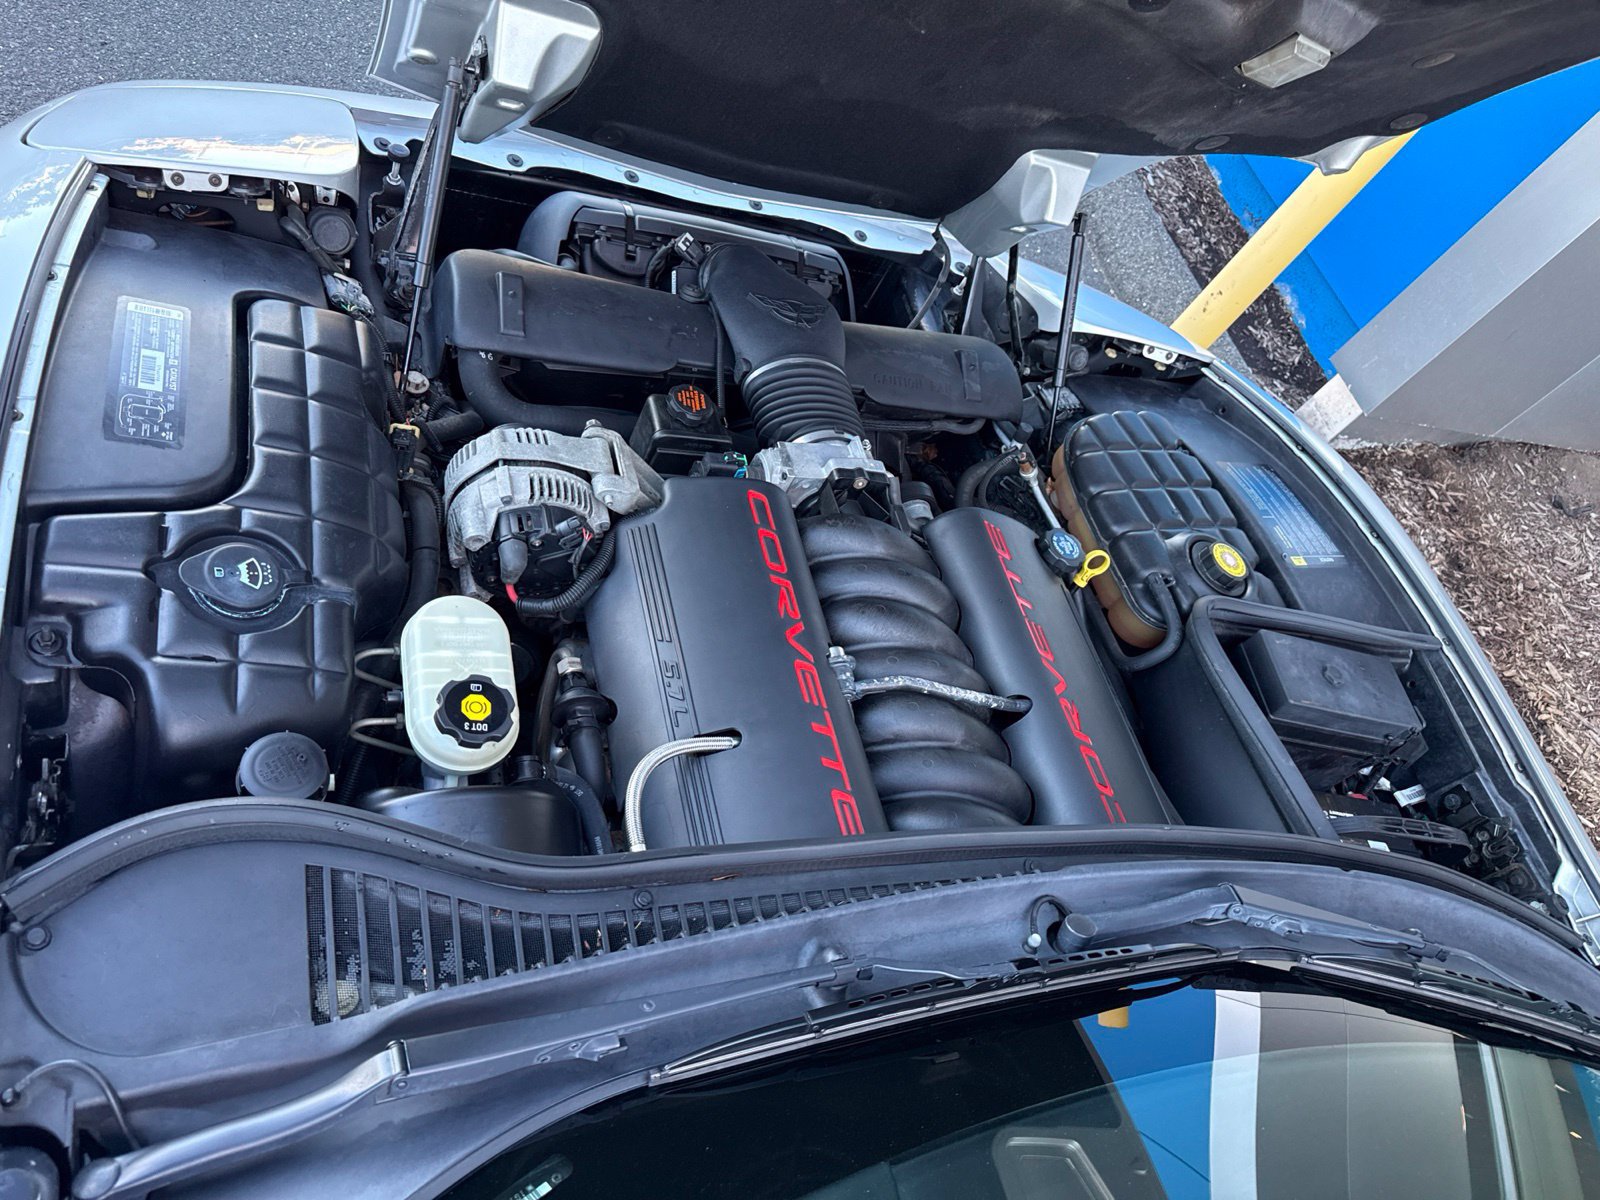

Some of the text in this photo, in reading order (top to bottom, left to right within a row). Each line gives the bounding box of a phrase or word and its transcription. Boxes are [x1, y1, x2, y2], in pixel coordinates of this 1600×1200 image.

[662, 660, 689, 728] 5.7L
[747, 489, 865, 836] CORVETTE
[464, 722, 488, 732] DOT 3
